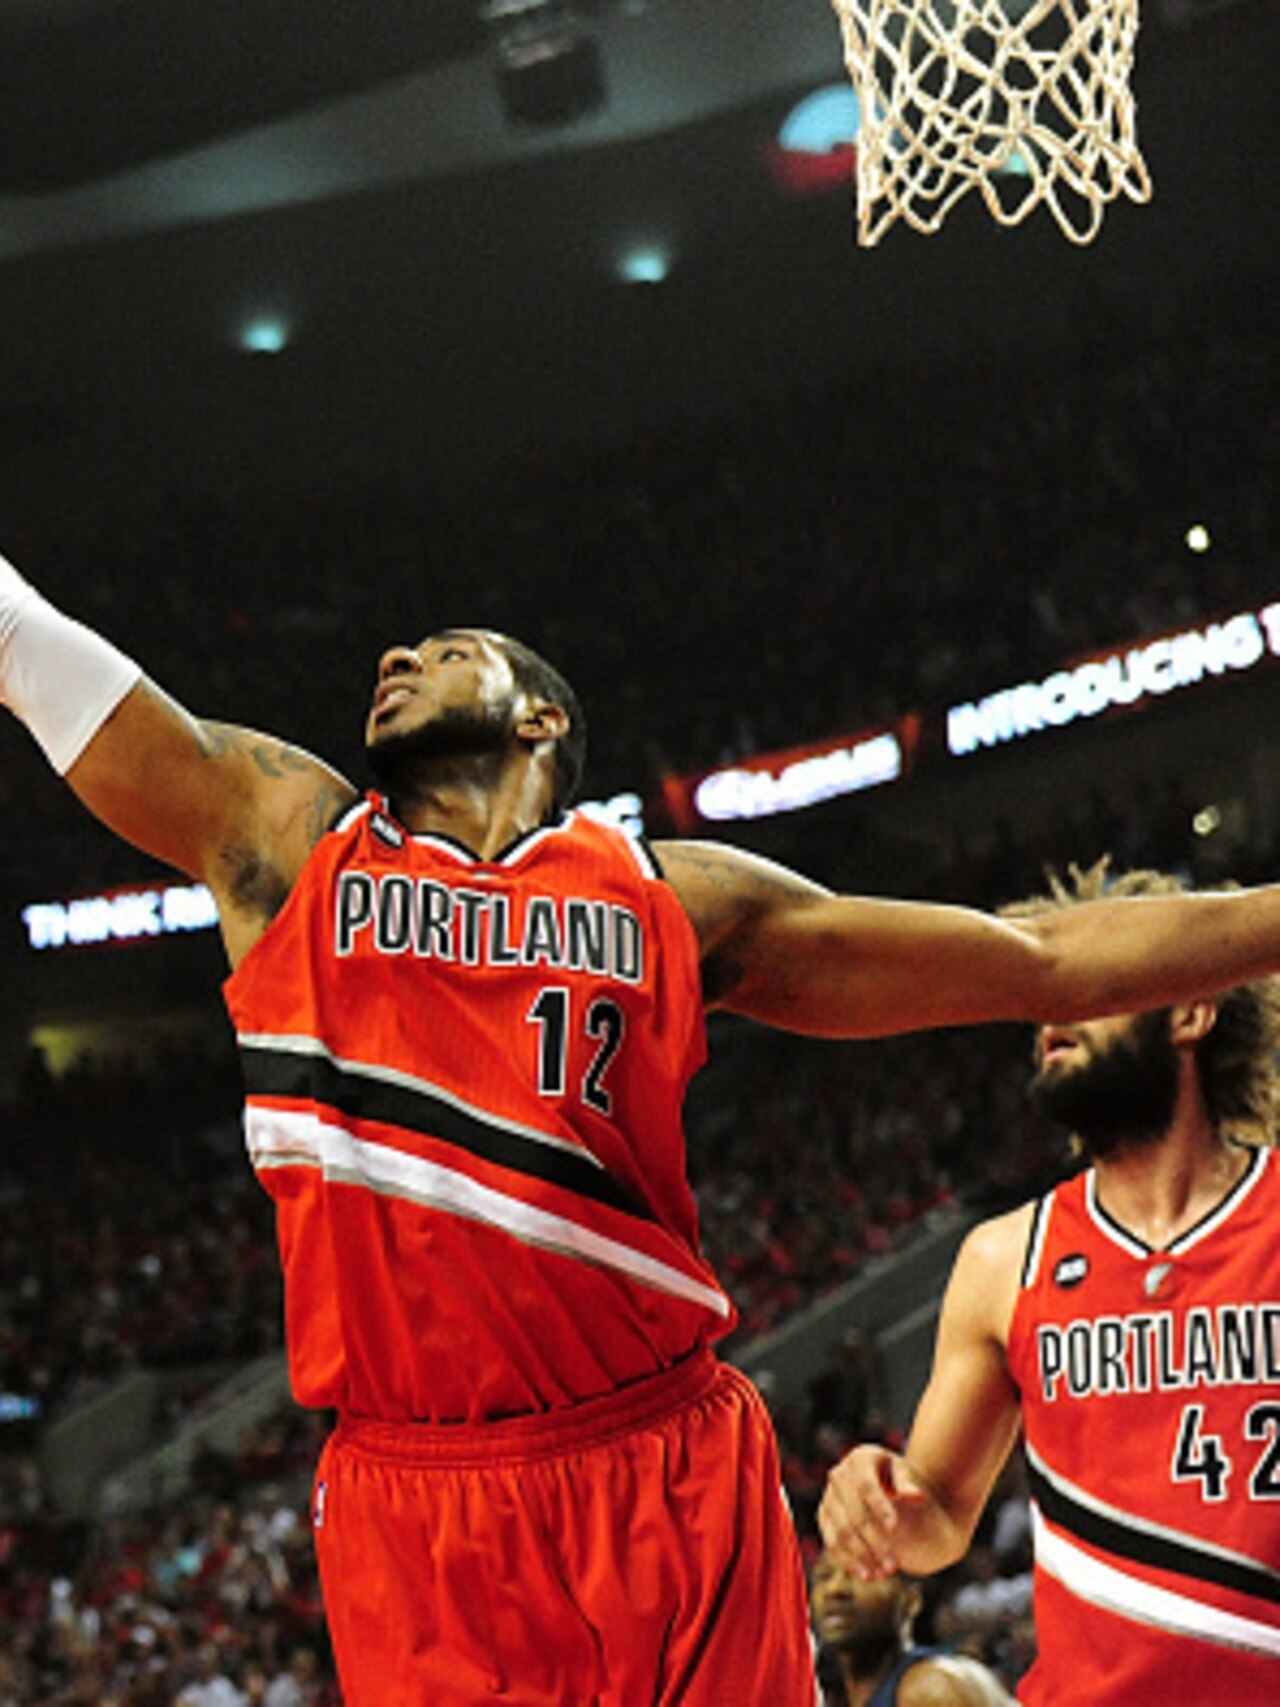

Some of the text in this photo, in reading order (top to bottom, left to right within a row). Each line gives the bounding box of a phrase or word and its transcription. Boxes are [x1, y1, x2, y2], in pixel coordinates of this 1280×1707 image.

[334, 869, 644, 986] PORTLAND
[525, 986, 624, 1116] 12
[1171, 1400, 1280, 1504] 42
